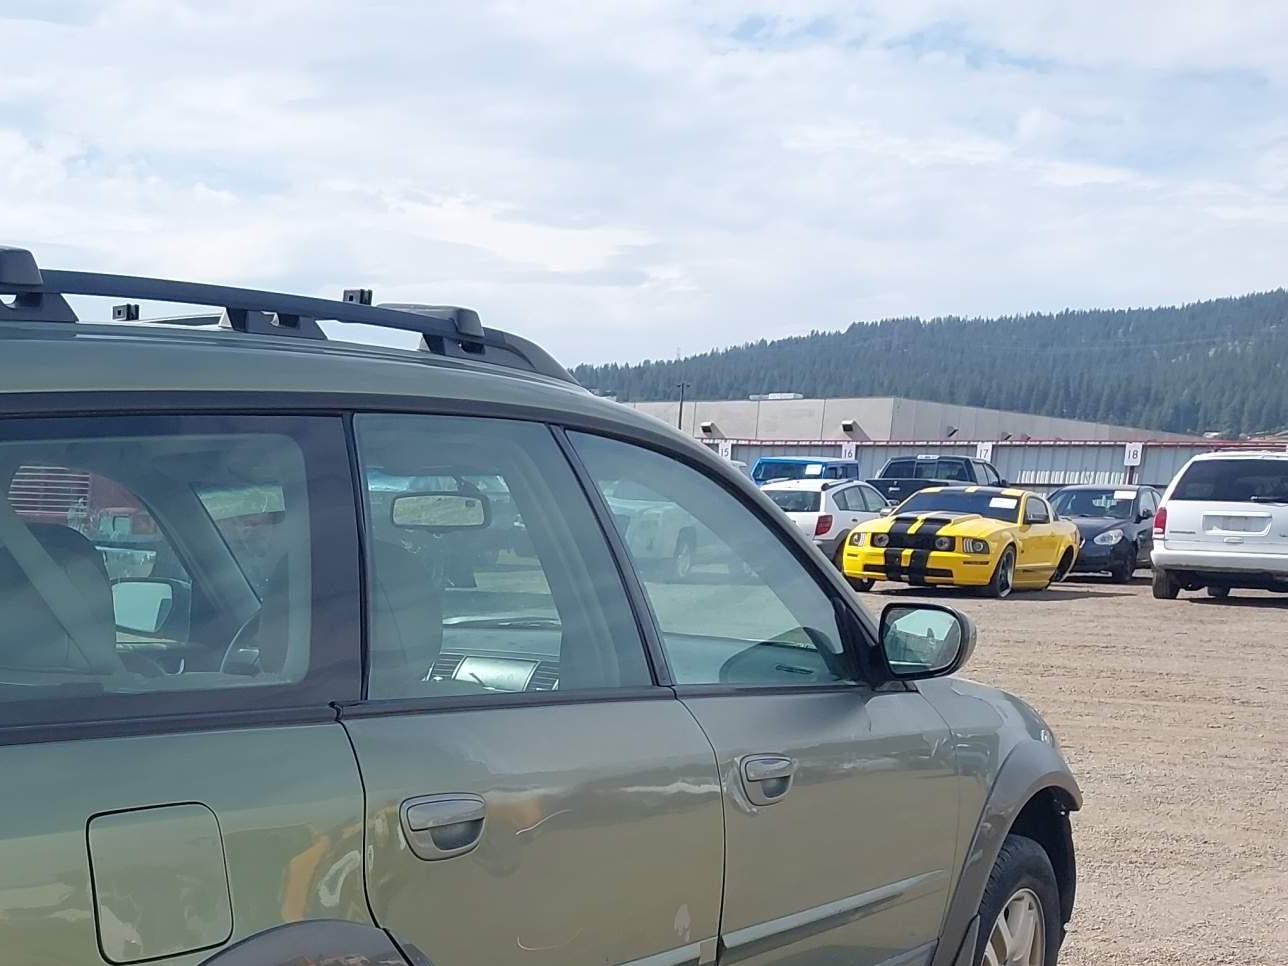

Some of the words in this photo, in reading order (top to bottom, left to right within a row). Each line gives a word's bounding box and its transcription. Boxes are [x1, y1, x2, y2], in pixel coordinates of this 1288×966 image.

[720, 447, 730, 457] 15
[843, 448, 853, 458] 16
[979, 448, 989, 459] 17
[1127, 449, 1140, 459] 18
